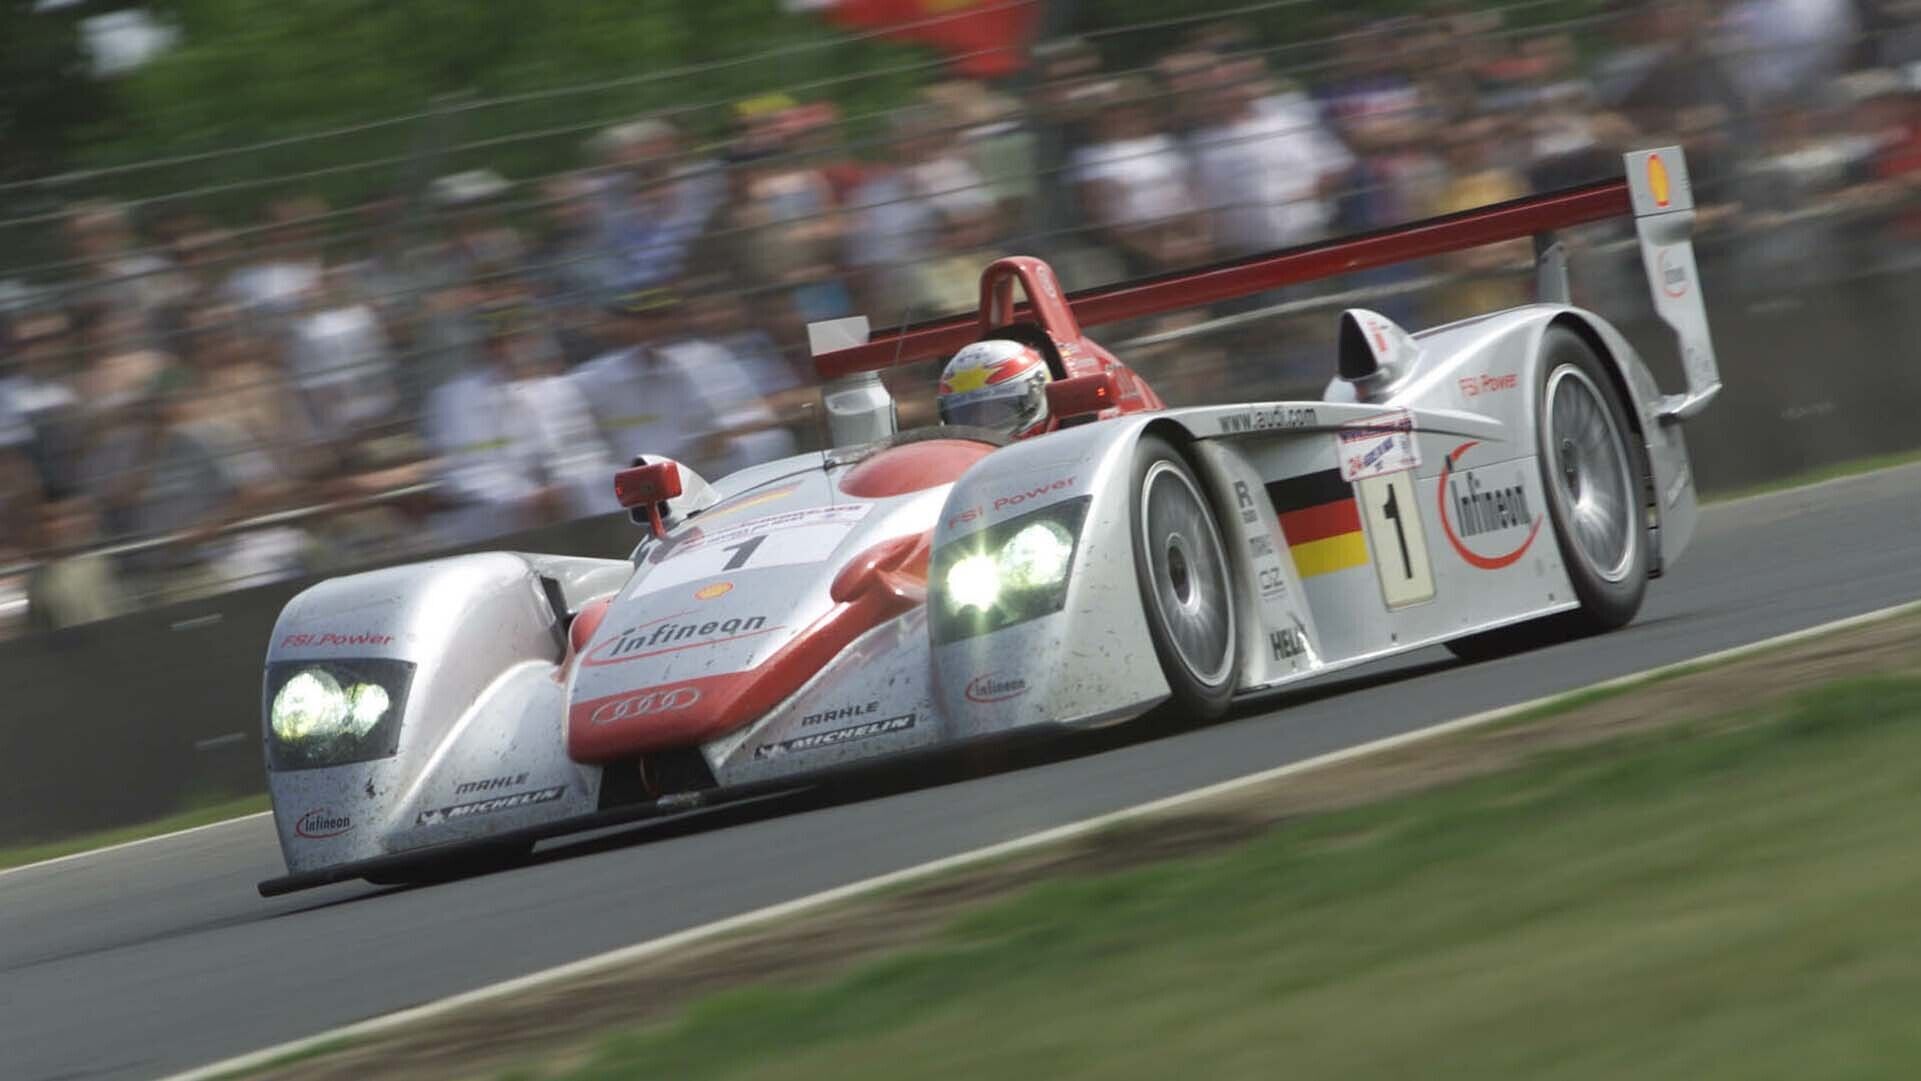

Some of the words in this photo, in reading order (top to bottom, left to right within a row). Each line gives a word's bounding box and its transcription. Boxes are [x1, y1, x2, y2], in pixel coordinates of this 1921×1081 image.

[1218, 406, 1318, 432] www.audi.com
[994, 475, 1075, 512] Power
[1383, 483, 1412, 579] 1
[722, 533, 768, 571] 1
[801, 701, 880, 727] MAHLE
[791, 716, 910, 750] MICHELIN
[455, 772, 529, 795] MAHLE
[447, 788, 561, 817] MICHELIN
